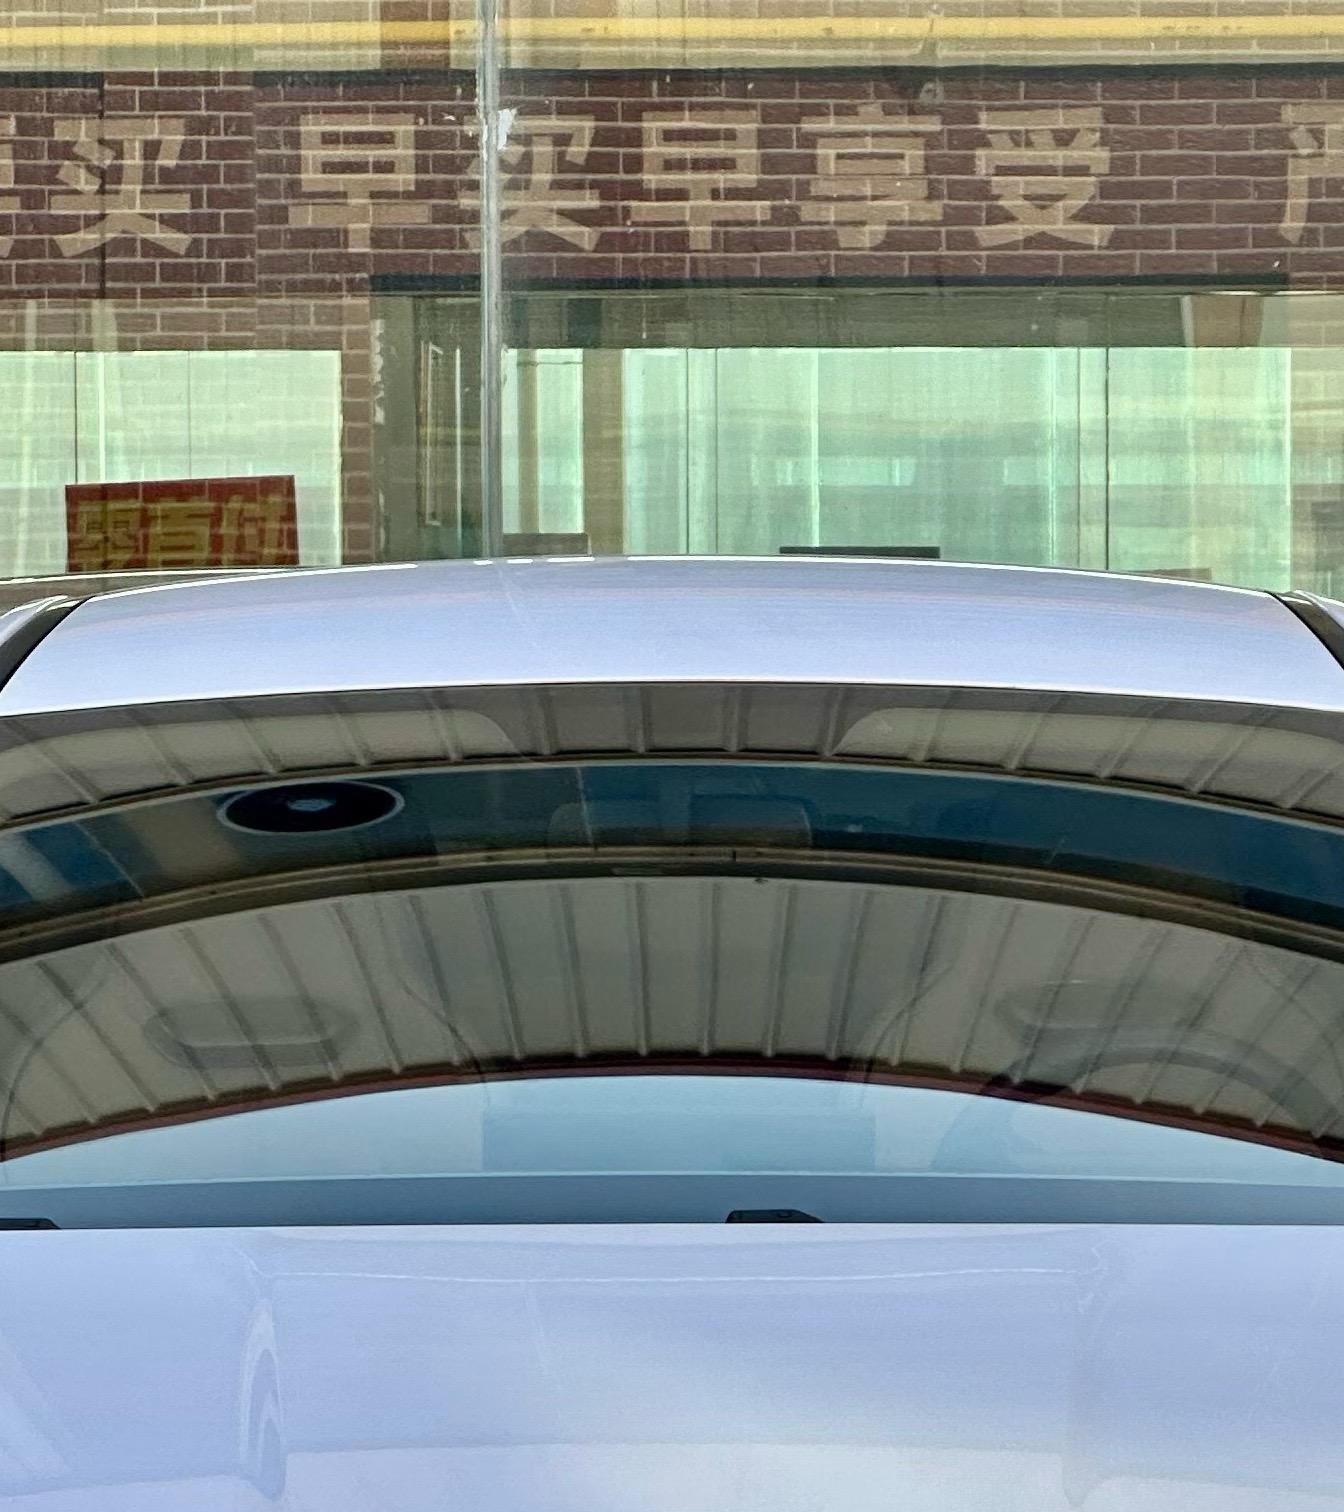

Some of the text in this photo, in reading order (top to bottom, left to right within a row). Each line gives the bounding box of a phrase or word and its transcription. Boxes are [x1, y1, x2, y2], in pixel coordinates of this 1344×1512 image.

[288, 103, 1115, 253] 早买早享受
